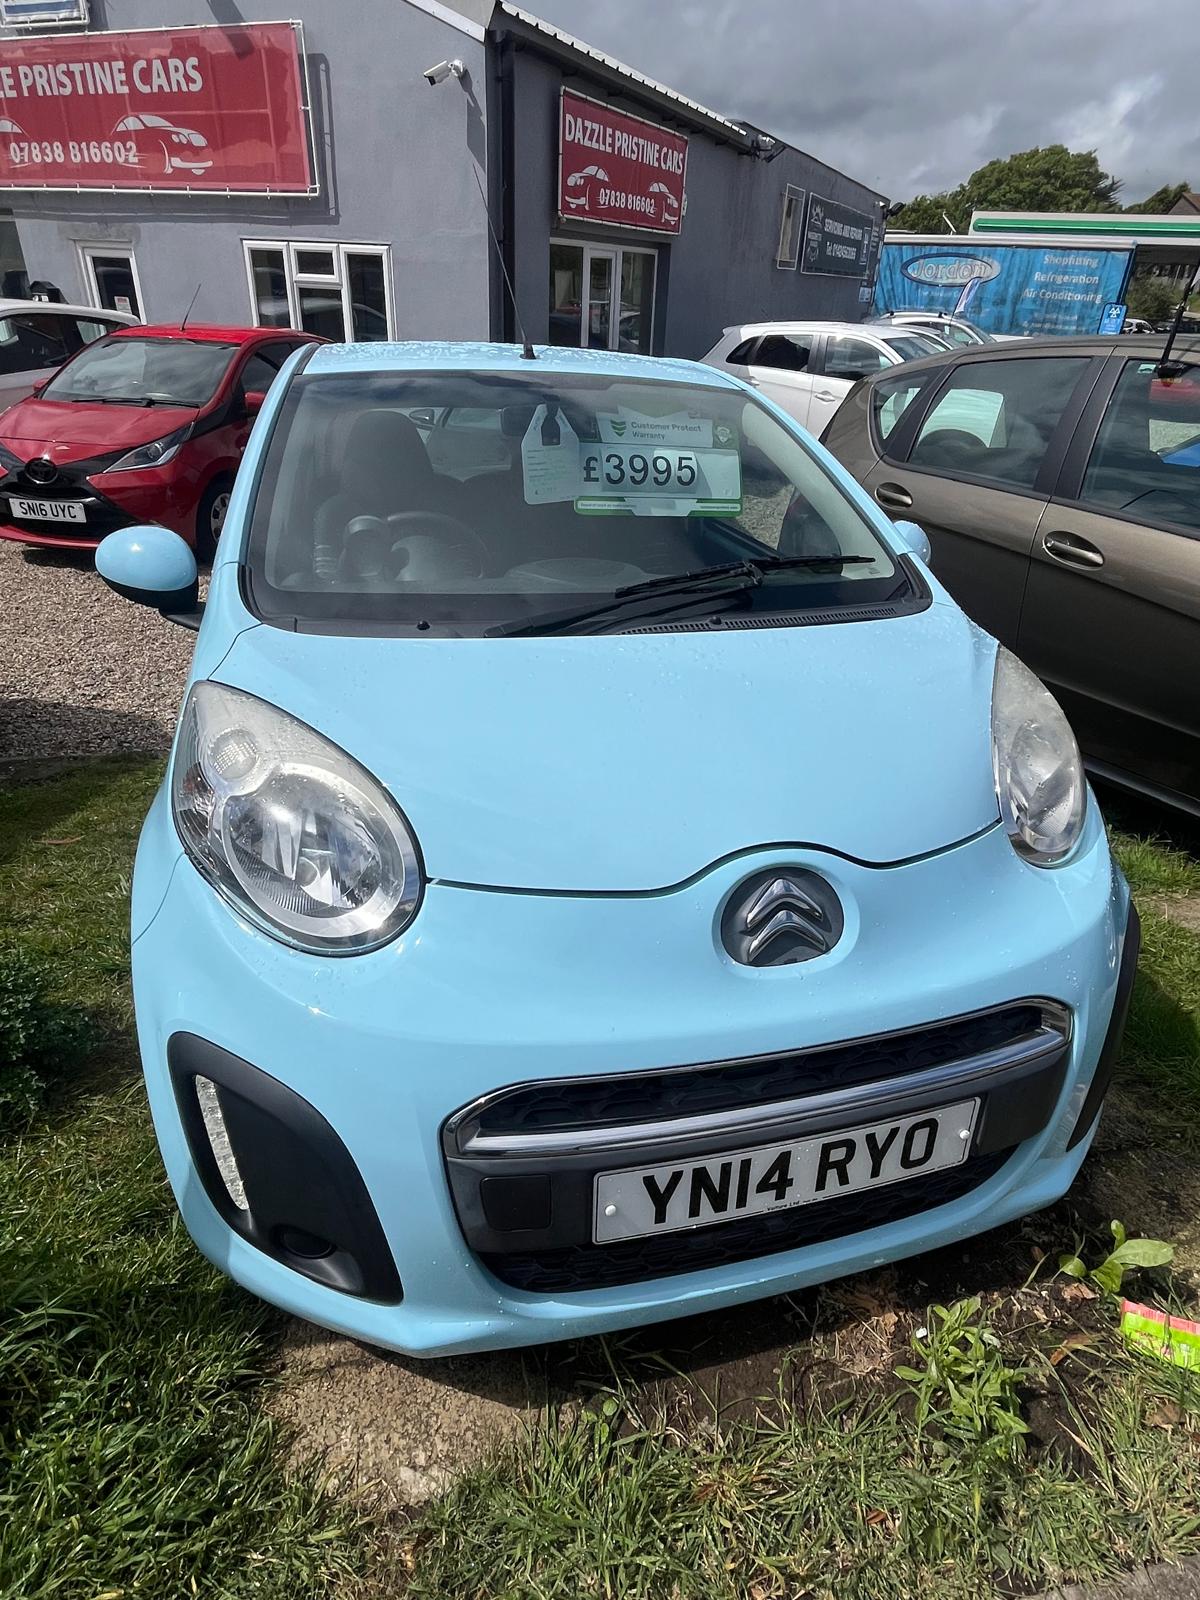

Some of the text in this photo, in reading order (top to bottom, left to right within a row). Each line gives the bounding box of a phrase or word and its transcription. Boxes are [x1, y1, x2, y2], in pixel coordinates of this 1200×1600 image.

[18, 61, 129, 97] PRISTINE
[133, 57, 203, 94] CARS
[10, 141, 139, 163] 07838 816602
[565, 113, 683, 175] DAZZLE PRISTINE CARS
[599, 188, 655, 214] 07838 816602
[1034, 271, 1099, 284] Refrigeration
[1023, 288, 1103, 304] Air Conditioning
[631, 421, 702, 433] Customer Protect
[632, 431, 666, 441] Warranty
[583, 453, 696, 487] £3995
[20, 502, 77, 519] SN16 UYC
[642, 1117, 939, 1225] YN14 RYO
